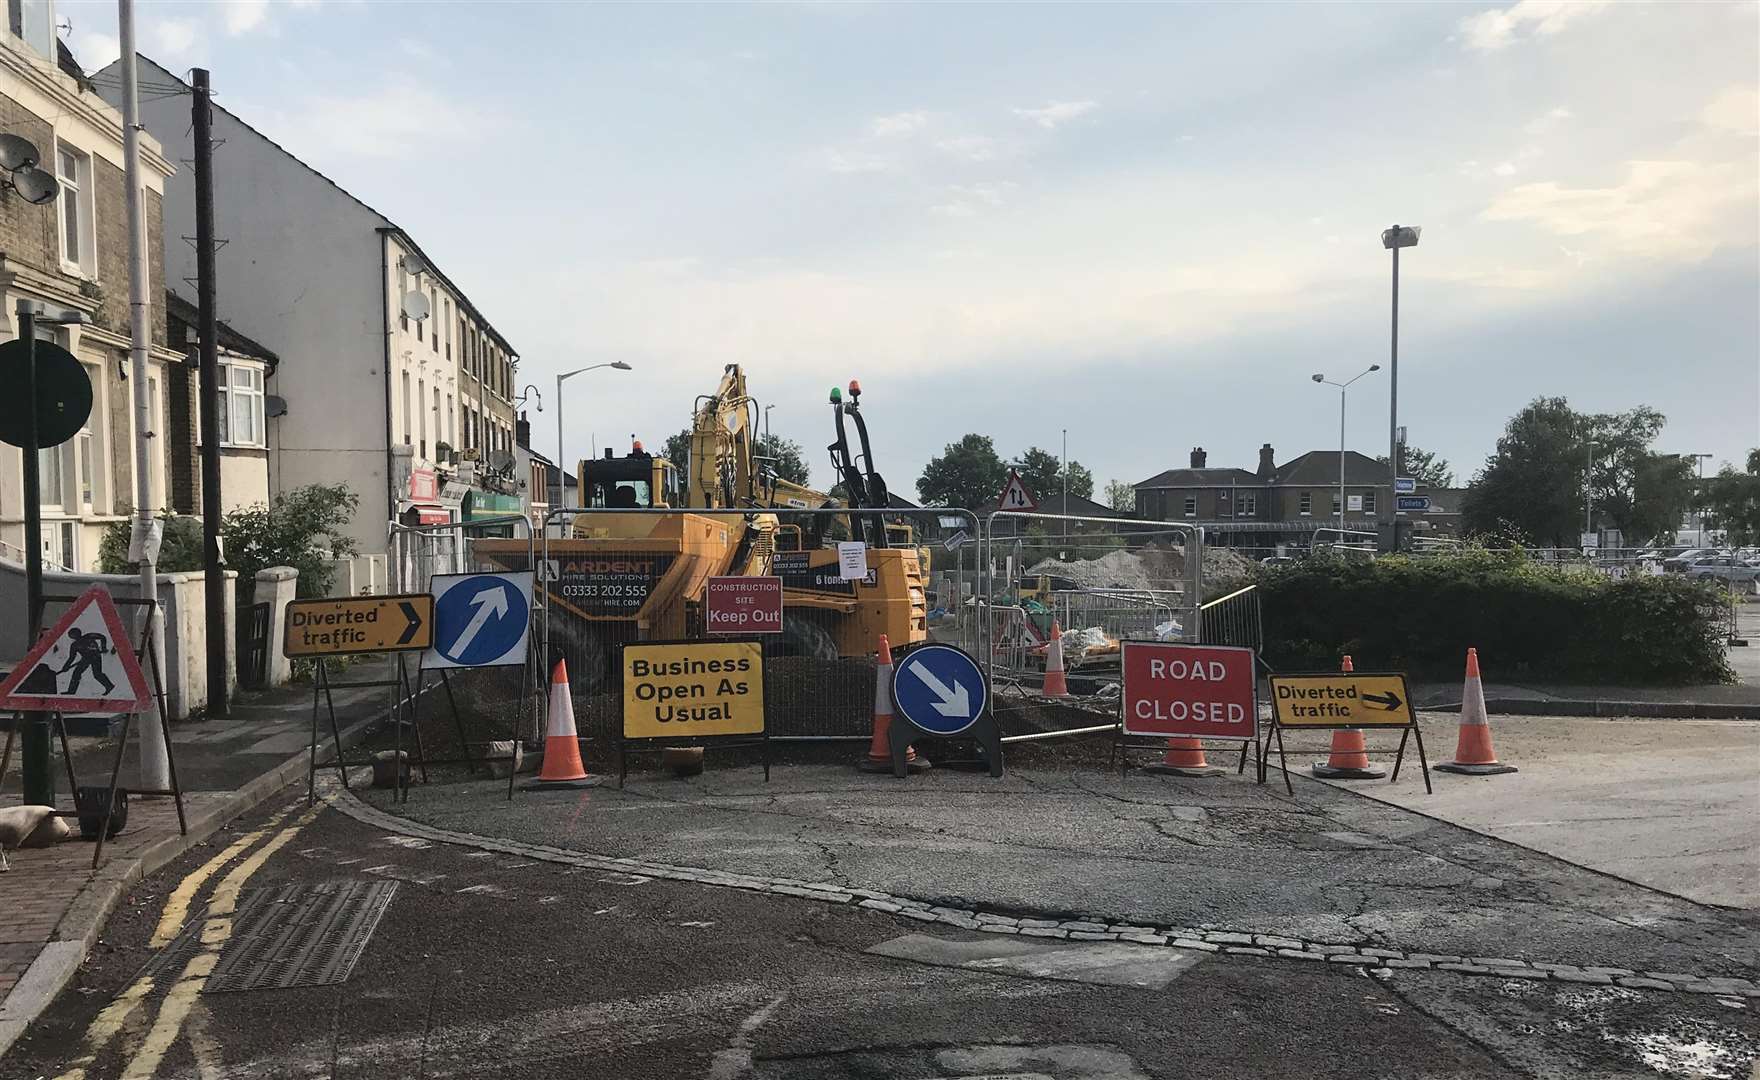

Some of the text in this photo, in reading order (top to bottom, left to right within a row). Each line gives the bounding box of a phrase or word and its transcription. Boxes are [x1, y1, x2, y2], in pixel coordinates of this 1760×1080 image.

[563, 561, 652, 573] ARDENT
[563, 585, 647, 596] 03333 202 555
[710, 583, 779, 591] CONSTRUCTION
[735, 596, 754, 604] SITE
[292, 608, 377, 626] Diverted
[710, 609, 779, 624] Keep Out
[303, 628, 366, 645] traffic
[632, 657, 750, 677] Business
[1151, 659, 1226, 681] ROAD
[635, 678, 749, 702] Open As
[1277, 685, 1357, 699] Diverted
[655, 702, 732, 723] Usual
[1135, 699, 1244, 723] CLOSED
[1291, 703, 1351, 717] traffic
